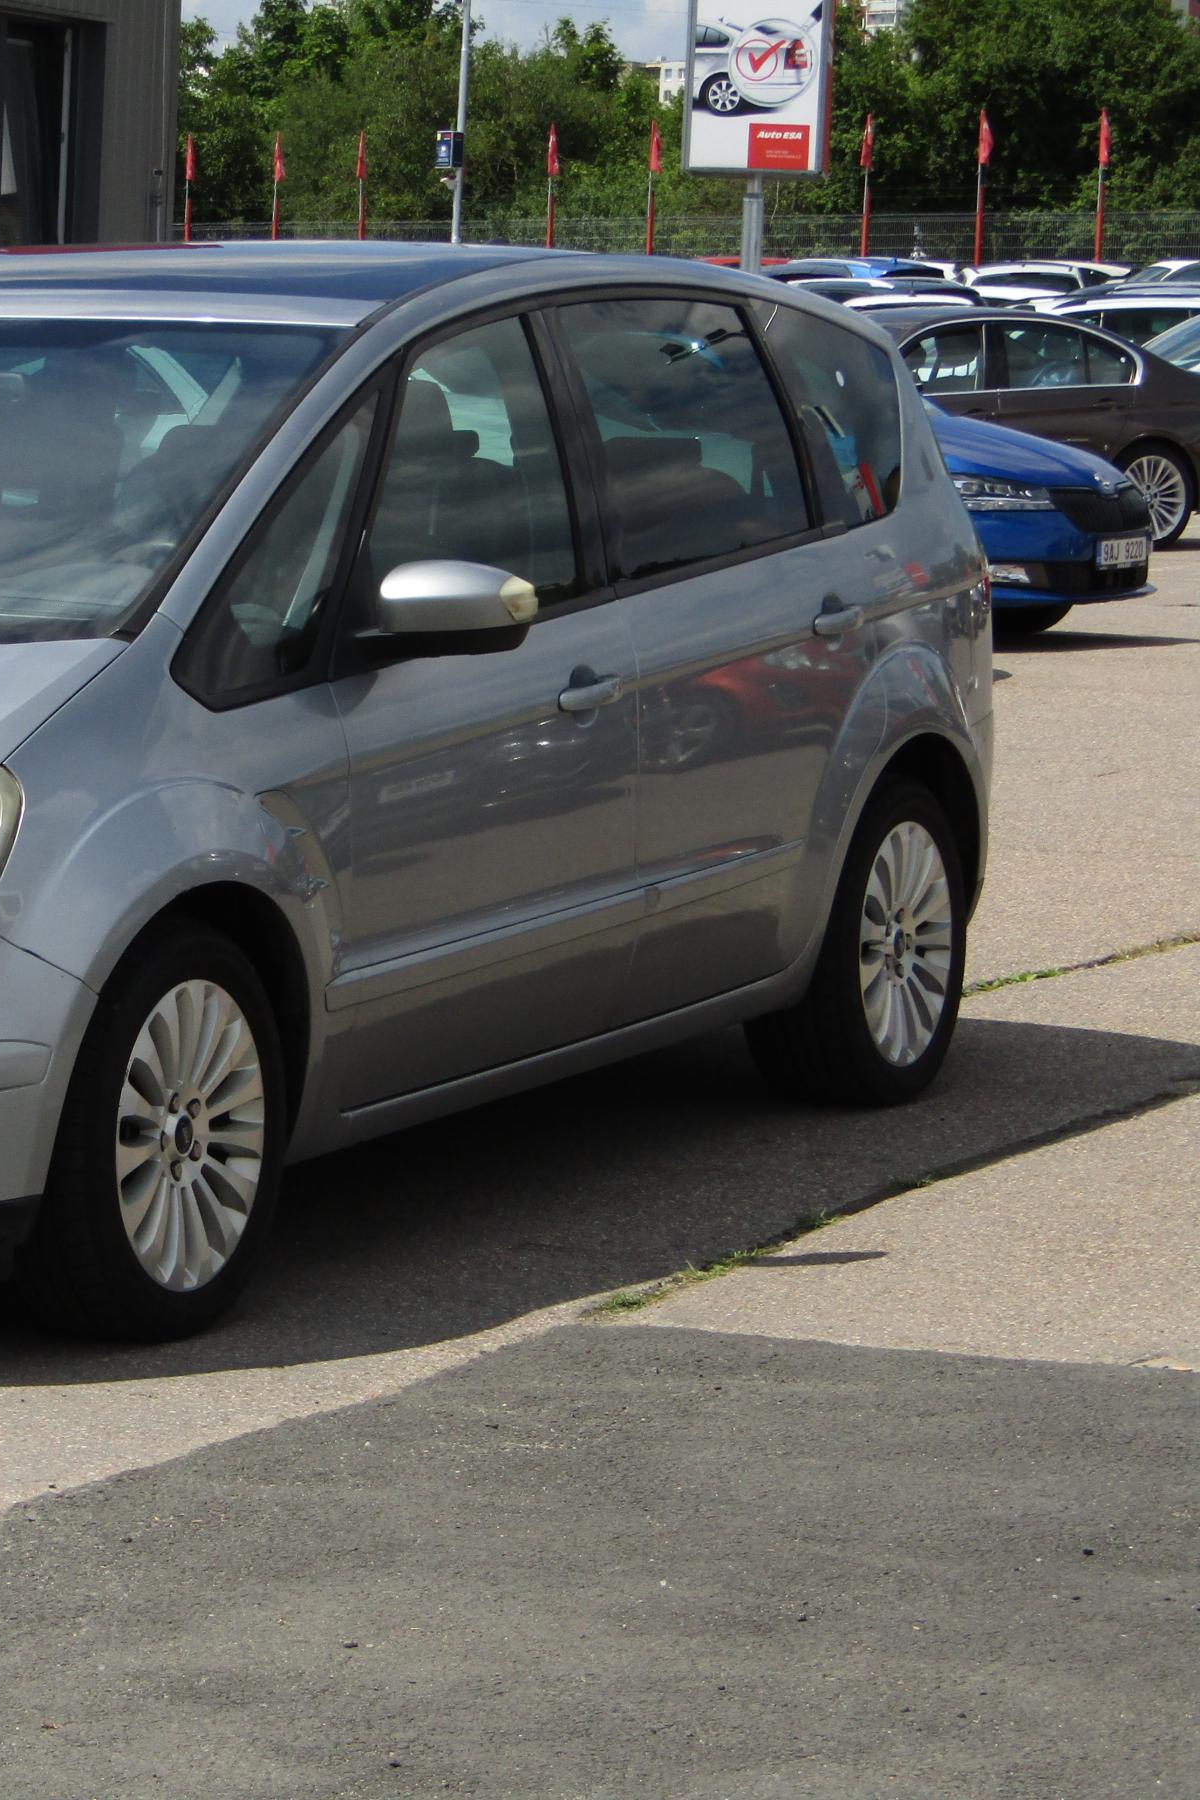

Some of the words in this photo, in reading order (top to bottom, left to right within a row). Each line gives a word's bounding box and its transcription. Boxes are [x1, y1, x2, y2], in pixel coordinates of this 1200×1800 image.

[757, 131, 782, 139] Auto
[783, 131, 802, 140] ESA
[1103, 543, 1120, 562] 9AJ
